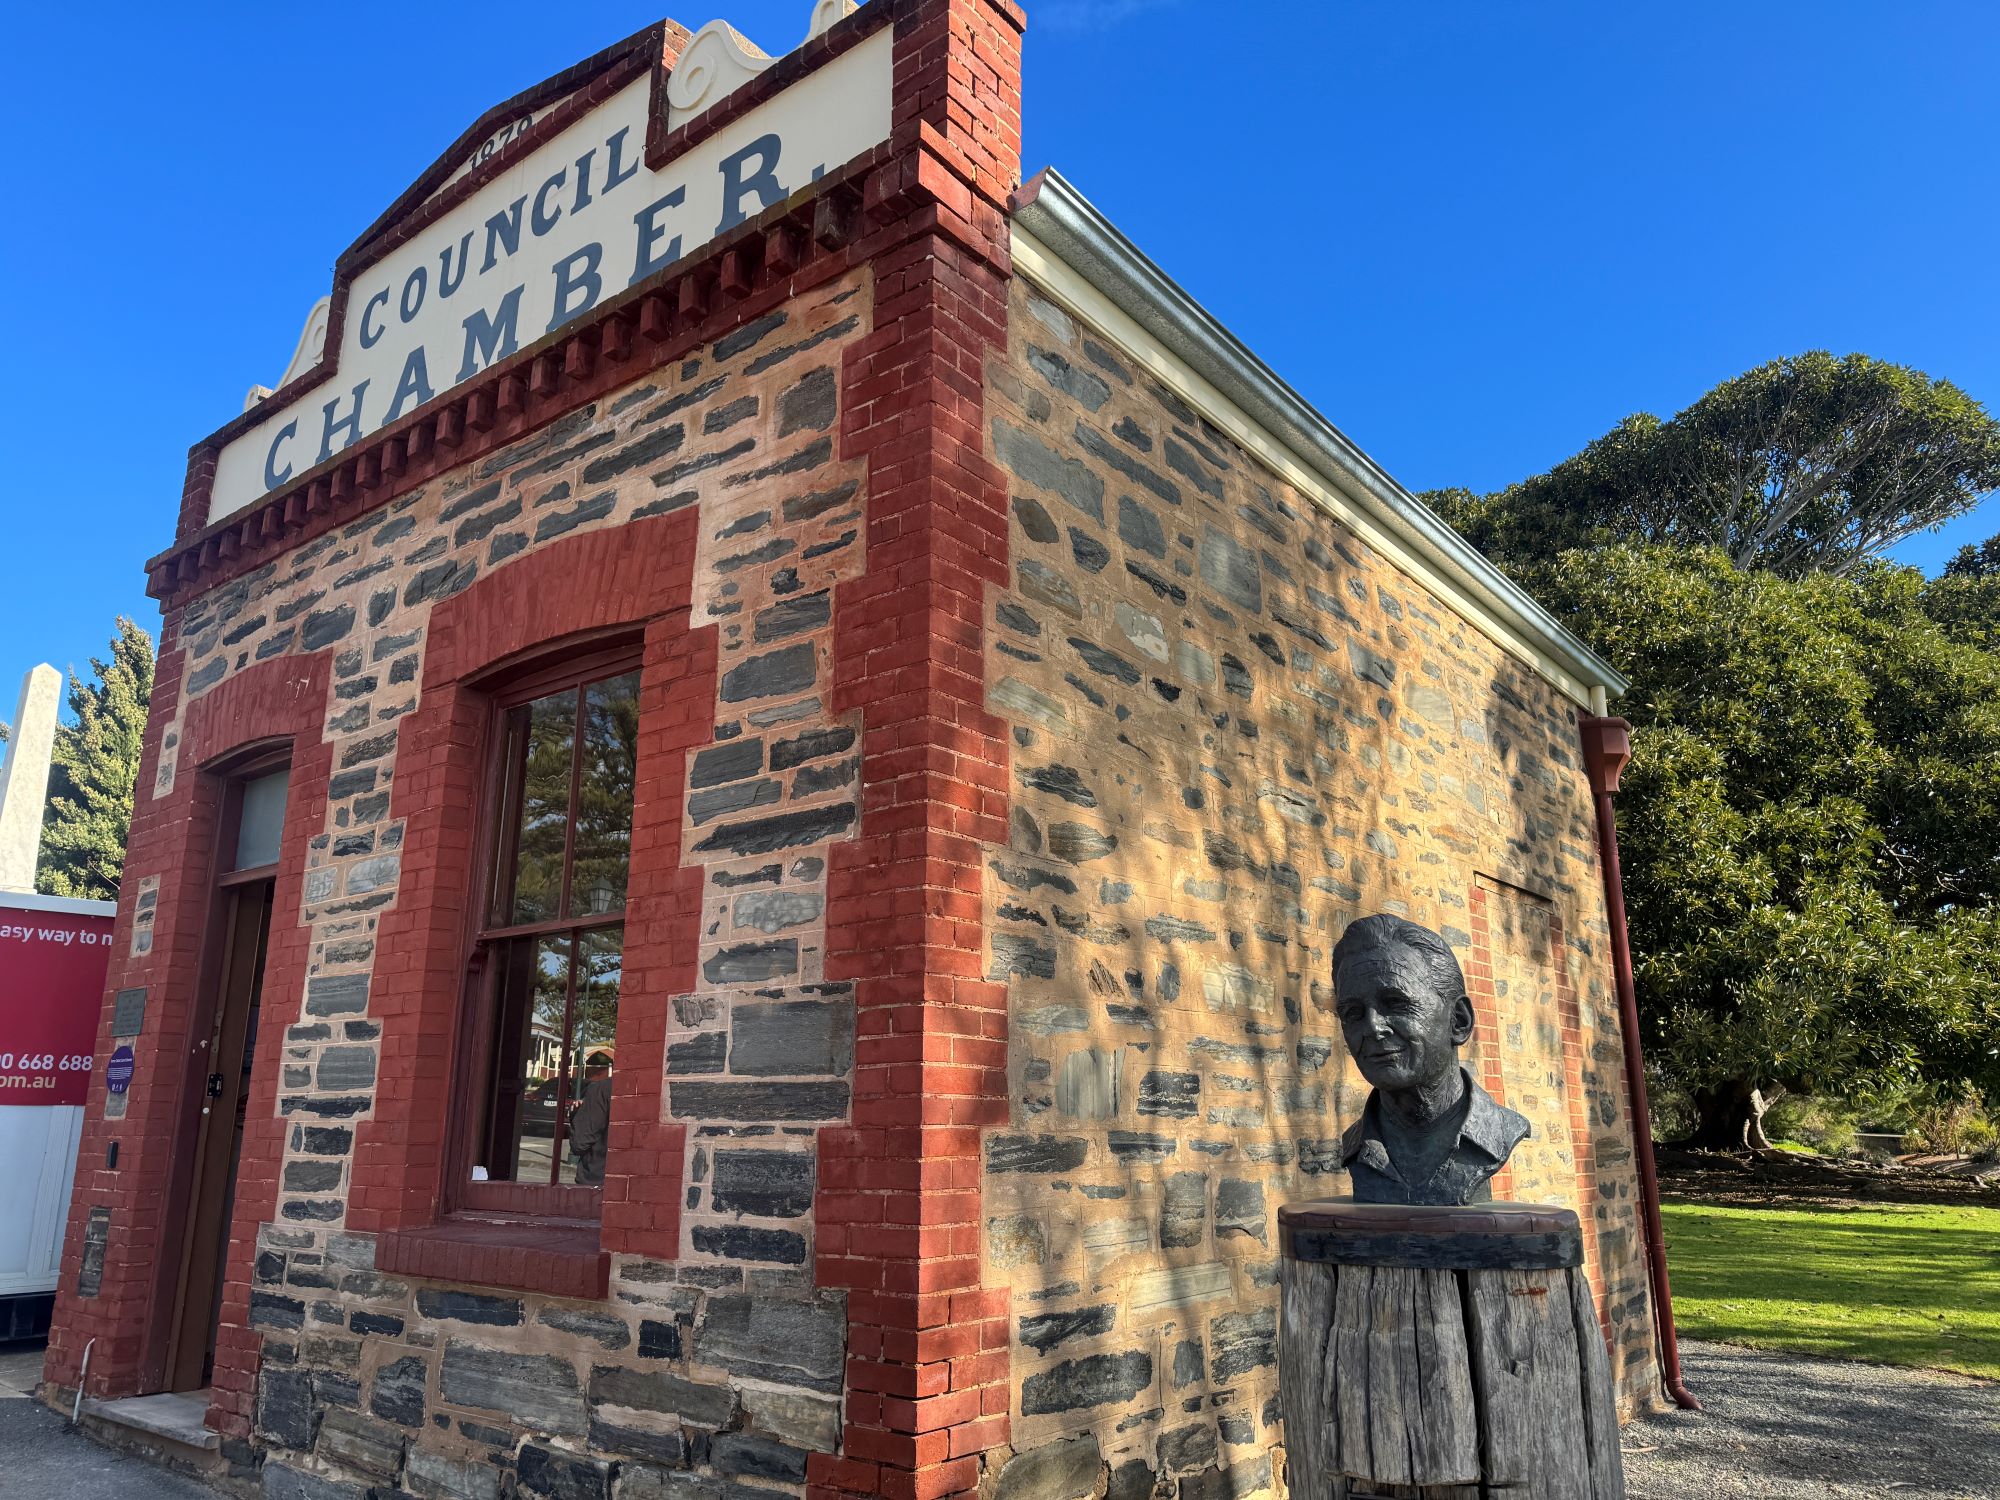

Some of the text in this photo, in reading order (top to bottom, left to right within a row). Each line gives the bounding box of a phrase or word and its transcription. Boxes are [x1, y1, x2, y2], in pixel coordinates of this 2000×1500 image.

[359, 125, 640, 350] COUNCIL
[37, 928, 76, 946] way
[79, 929, 97, 945] to
[18, 1053, 54, 1071] 668
[58, 1054, 94, 1071] 688
